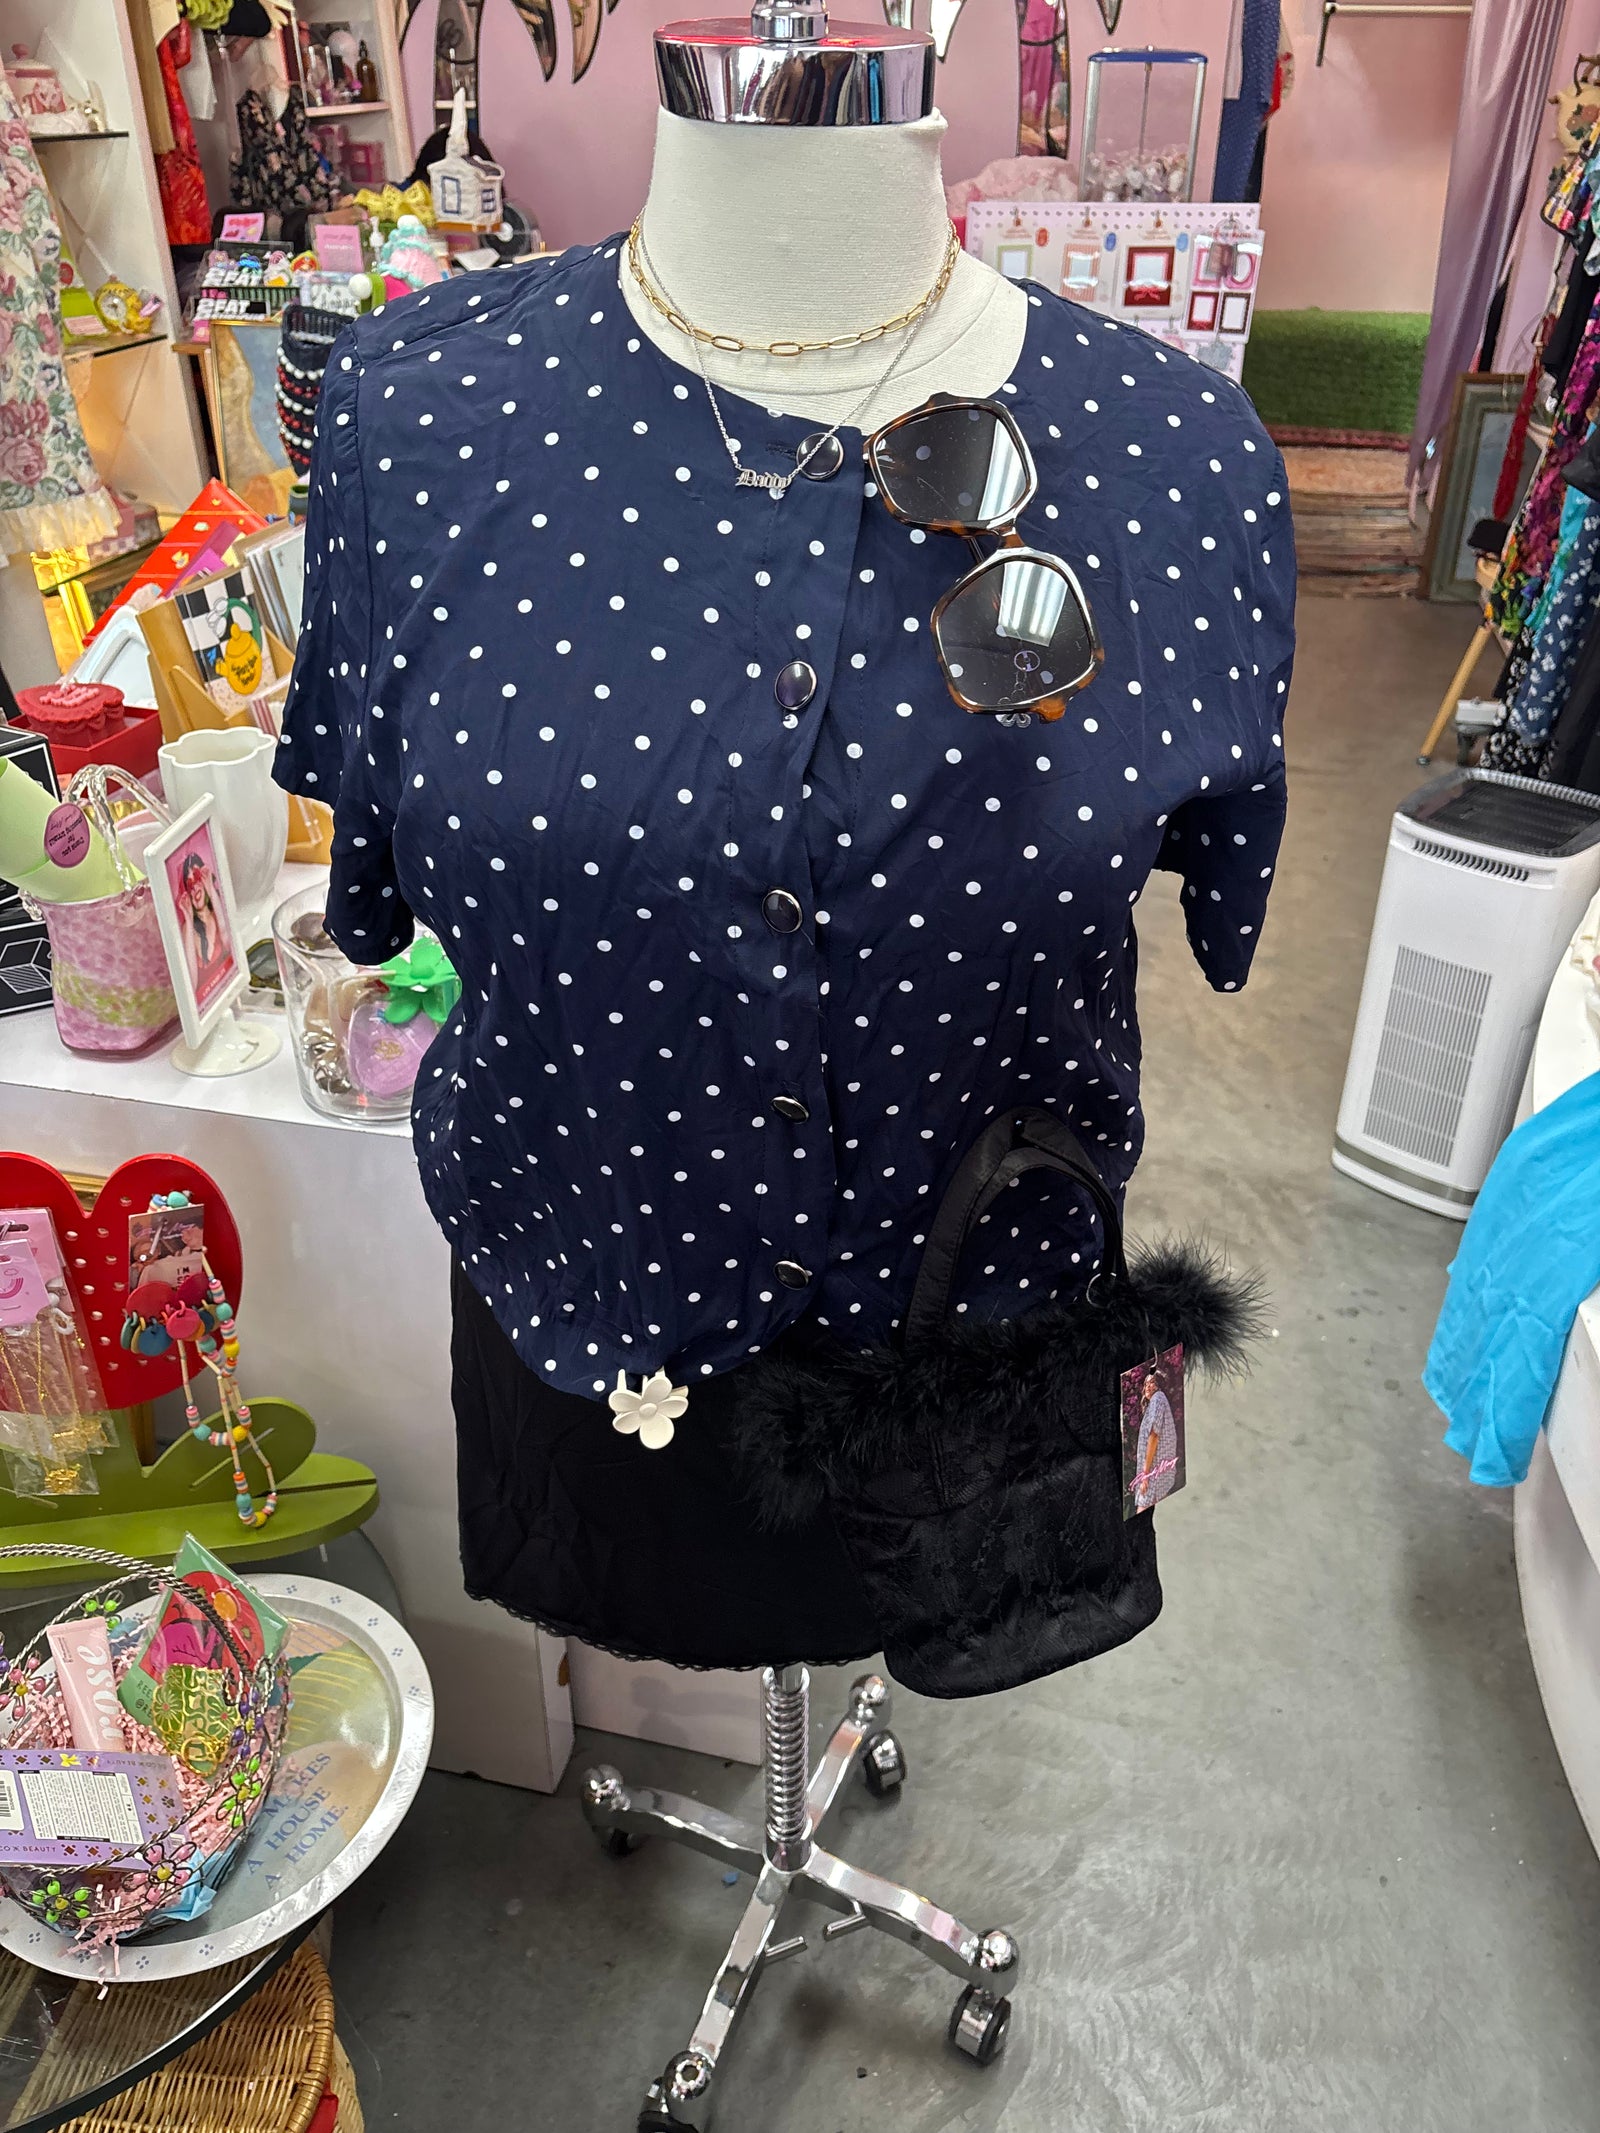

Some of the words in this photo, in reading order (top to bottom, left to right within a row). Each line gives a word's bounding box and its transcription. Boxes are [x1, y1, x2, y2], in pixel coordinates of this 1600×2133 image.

[77, 1645, 124, 1740] rose
[263, 1752, 332, 1818] MKES
[247, 1859, 264, 1875] A
[264, 1786, 332, 1851] HOUSE
[265, 1873, 282, 1890] A
[285, 1805, 349, 1865] HOME.
